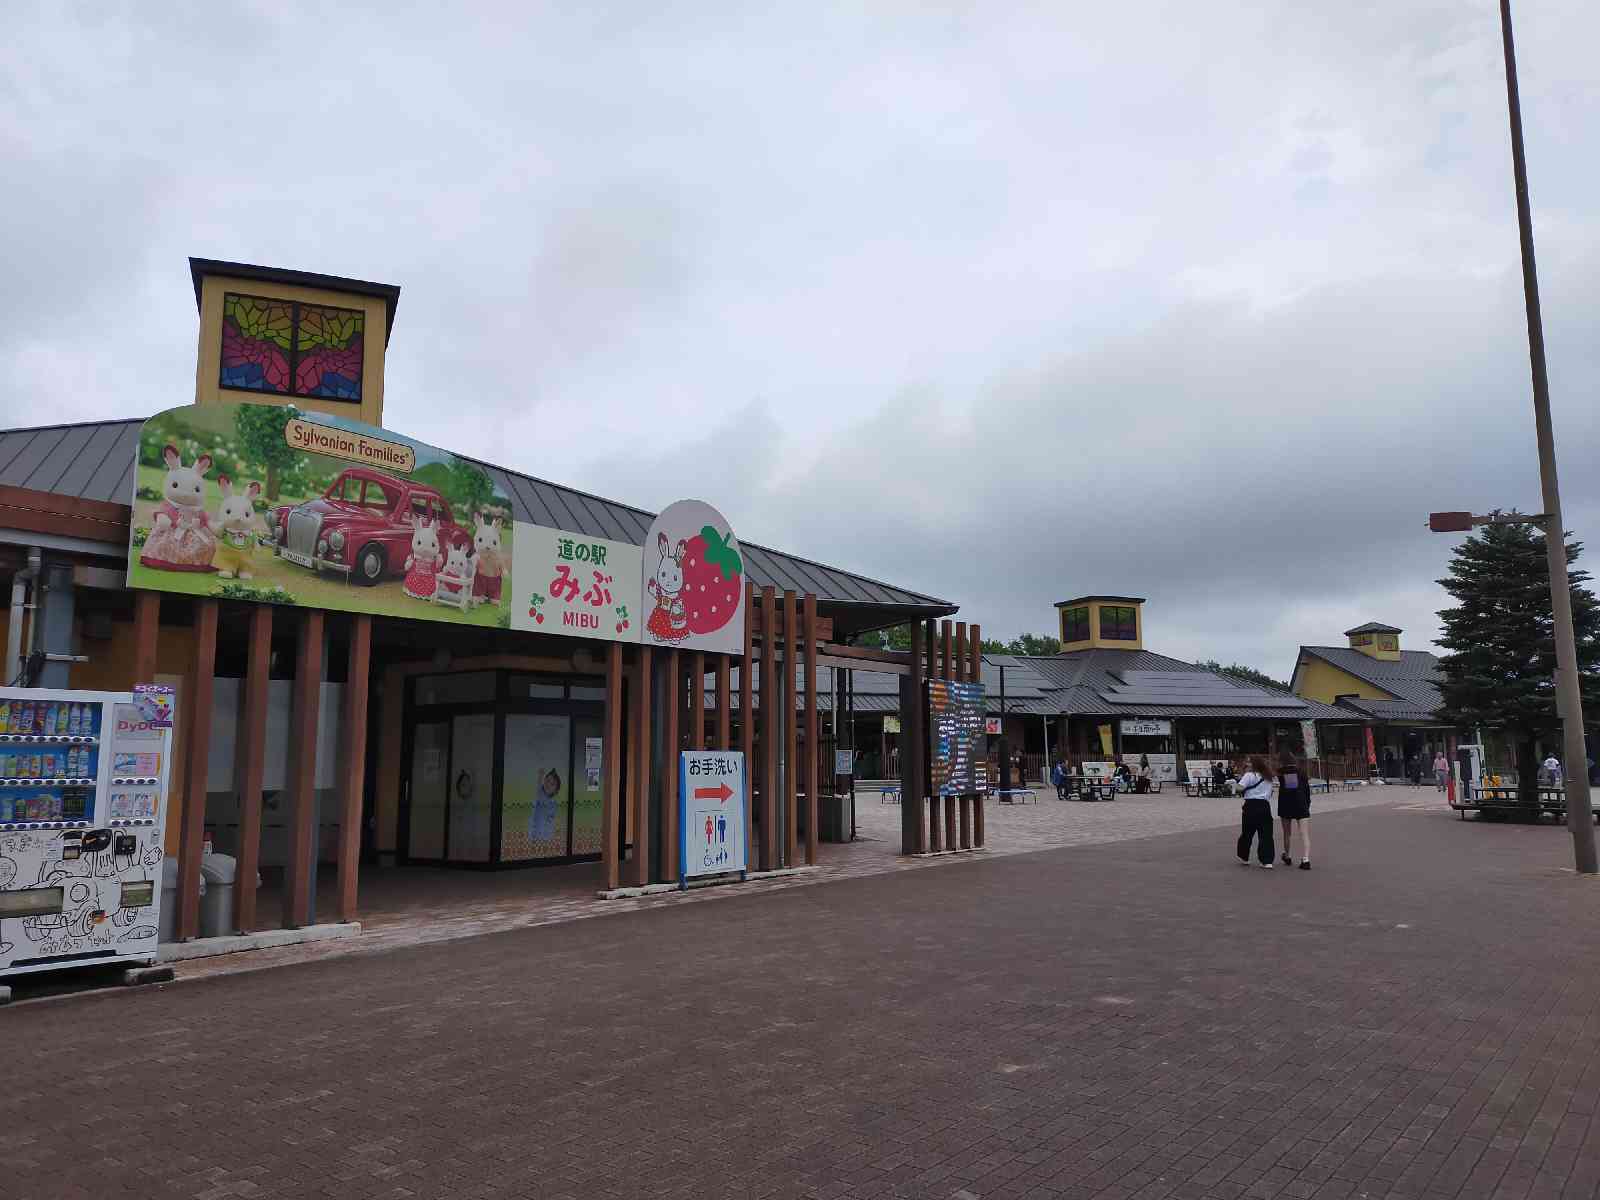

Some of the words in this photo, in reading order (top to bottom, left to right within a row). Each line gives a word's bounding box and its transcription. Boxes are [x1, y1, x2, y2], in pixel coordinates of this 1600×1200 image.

[294, 425, 354, 453] Sylvanian
[359, 440, 406, 464] Families
[558, 538, 607, 566] 道の駅
[550, 565, 612, 607] みぶ
[563, 611, 599, 629] MIBU
[689, 758, 738, 776] お手洗い
